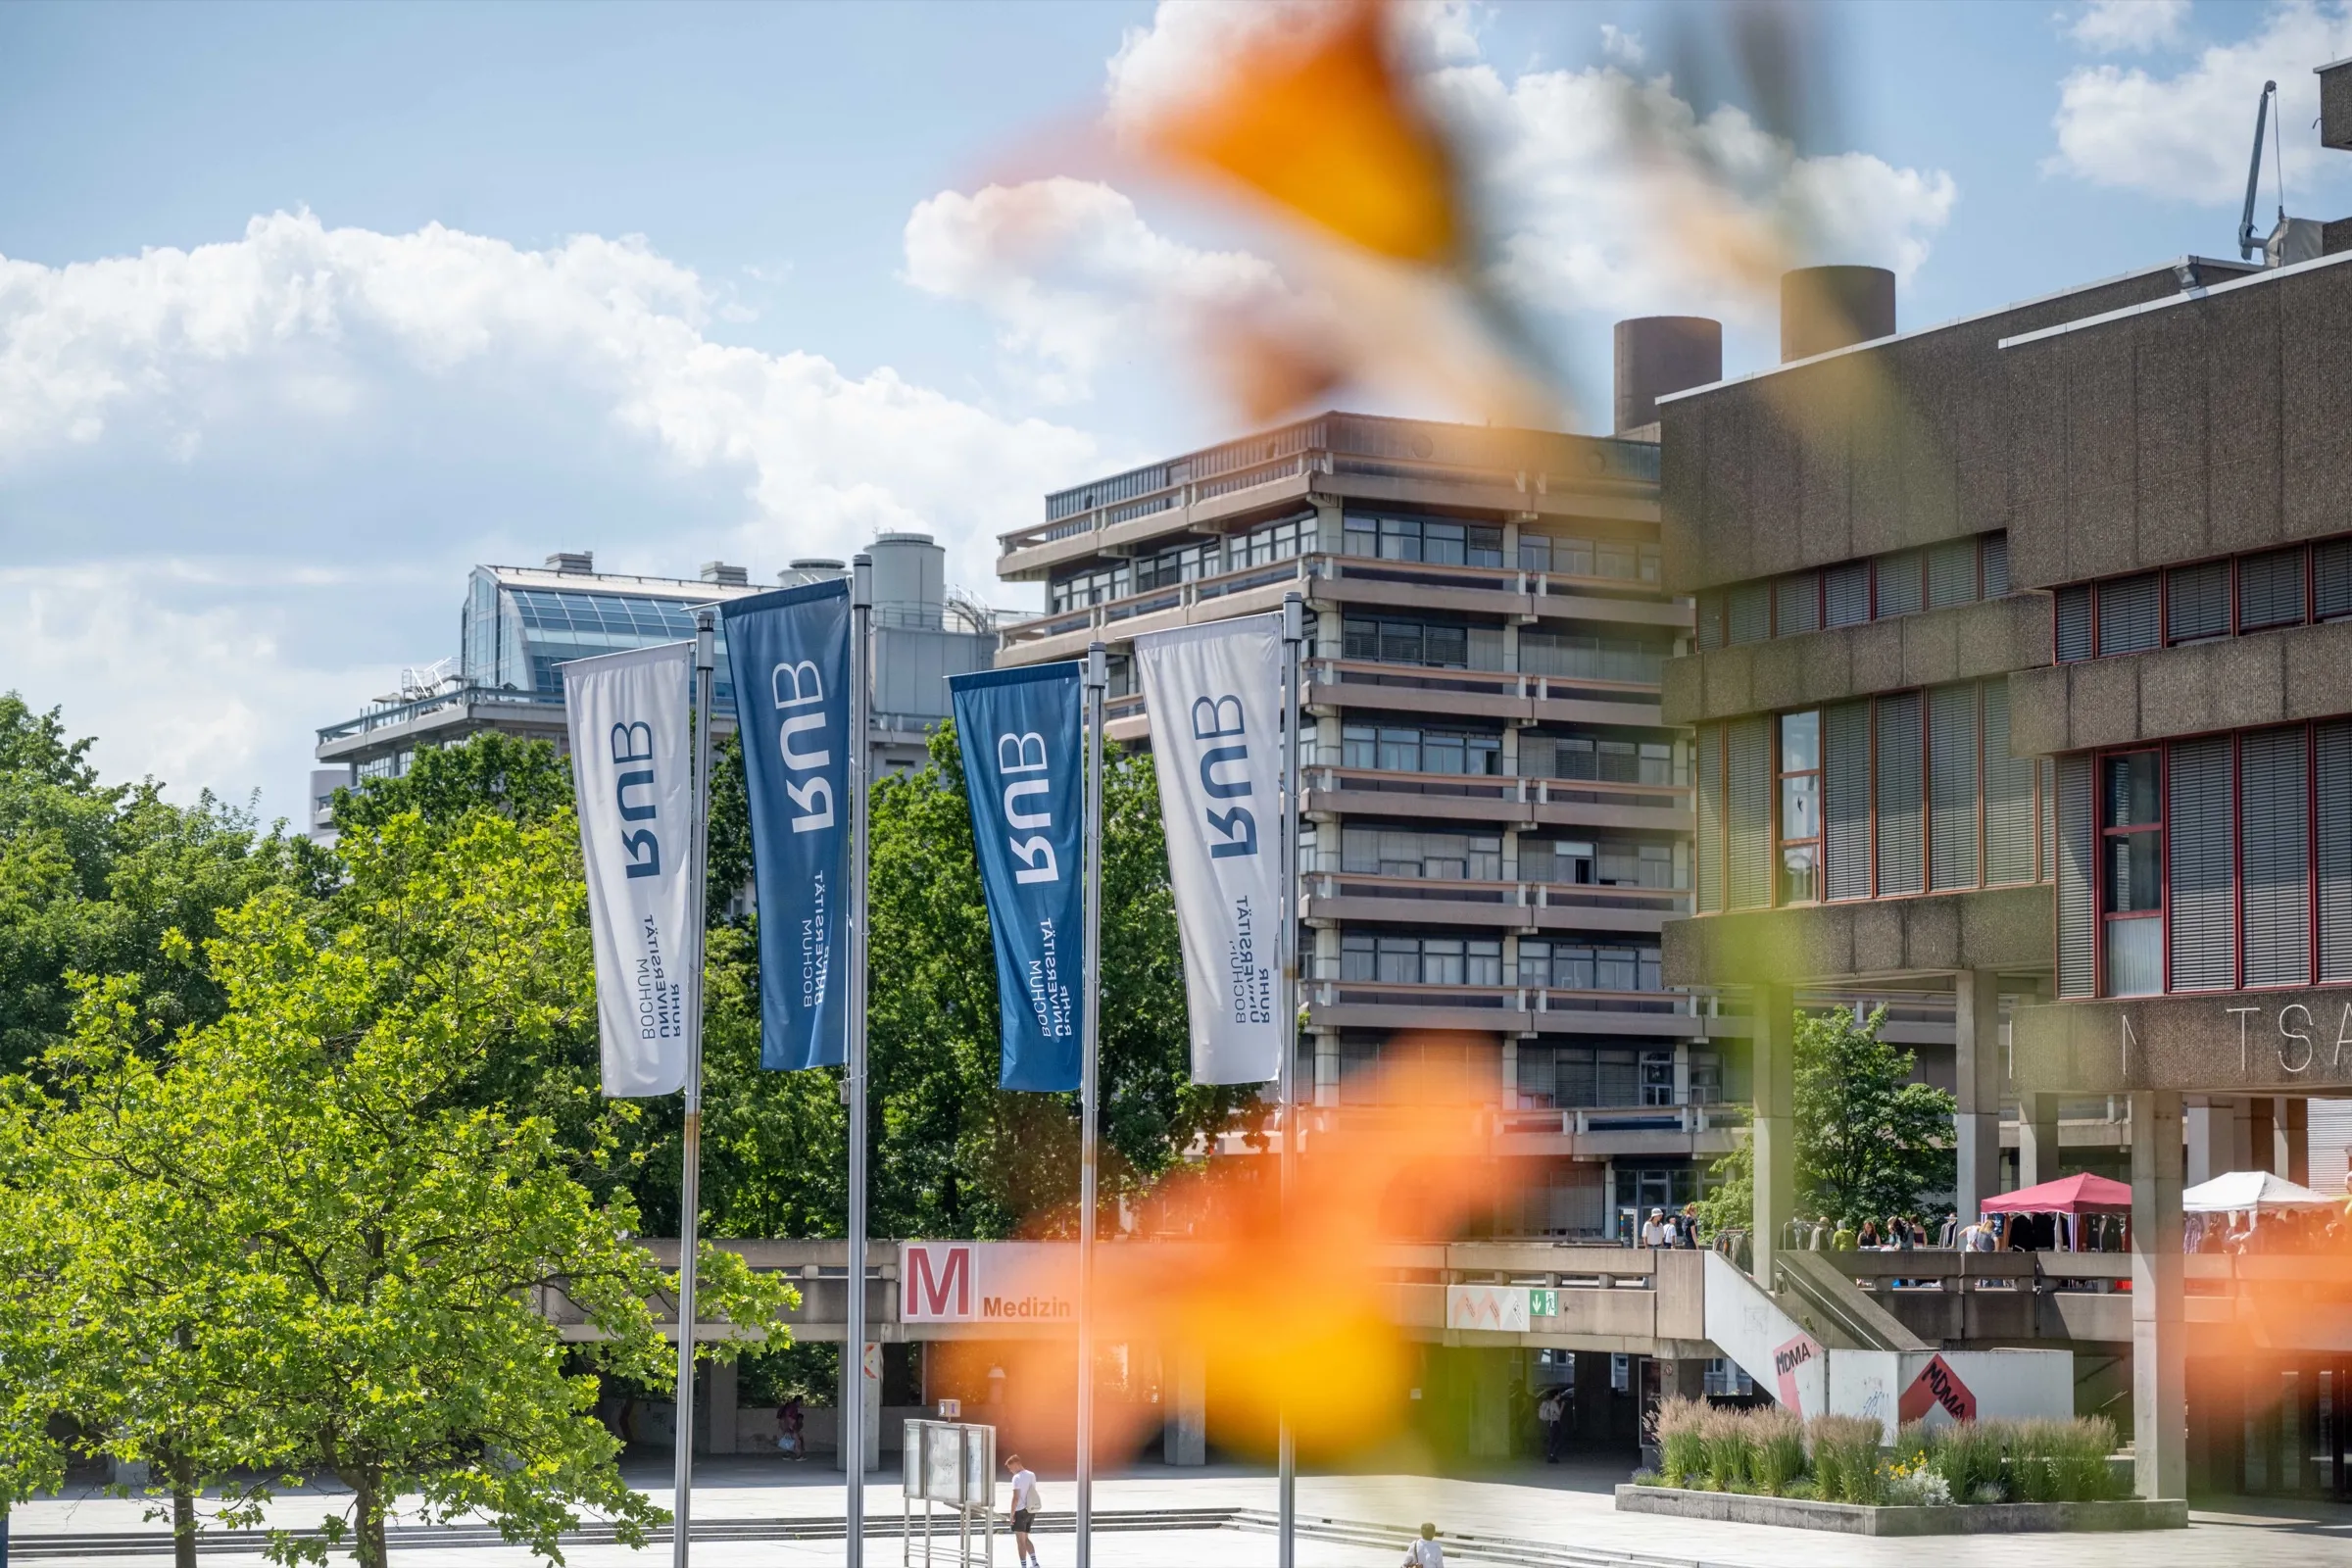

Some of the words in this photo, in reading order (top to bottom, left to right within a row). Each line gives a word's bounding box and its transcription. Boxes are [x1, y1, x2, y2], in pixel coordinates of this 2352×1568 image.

[906, 1247, 970, 1316] M
[983, 1297, 1071, 1318] Medizin
[1776, 1342, 1811, 1376] MDMA
[1921, 1361, 1966, 1420] MDMA
